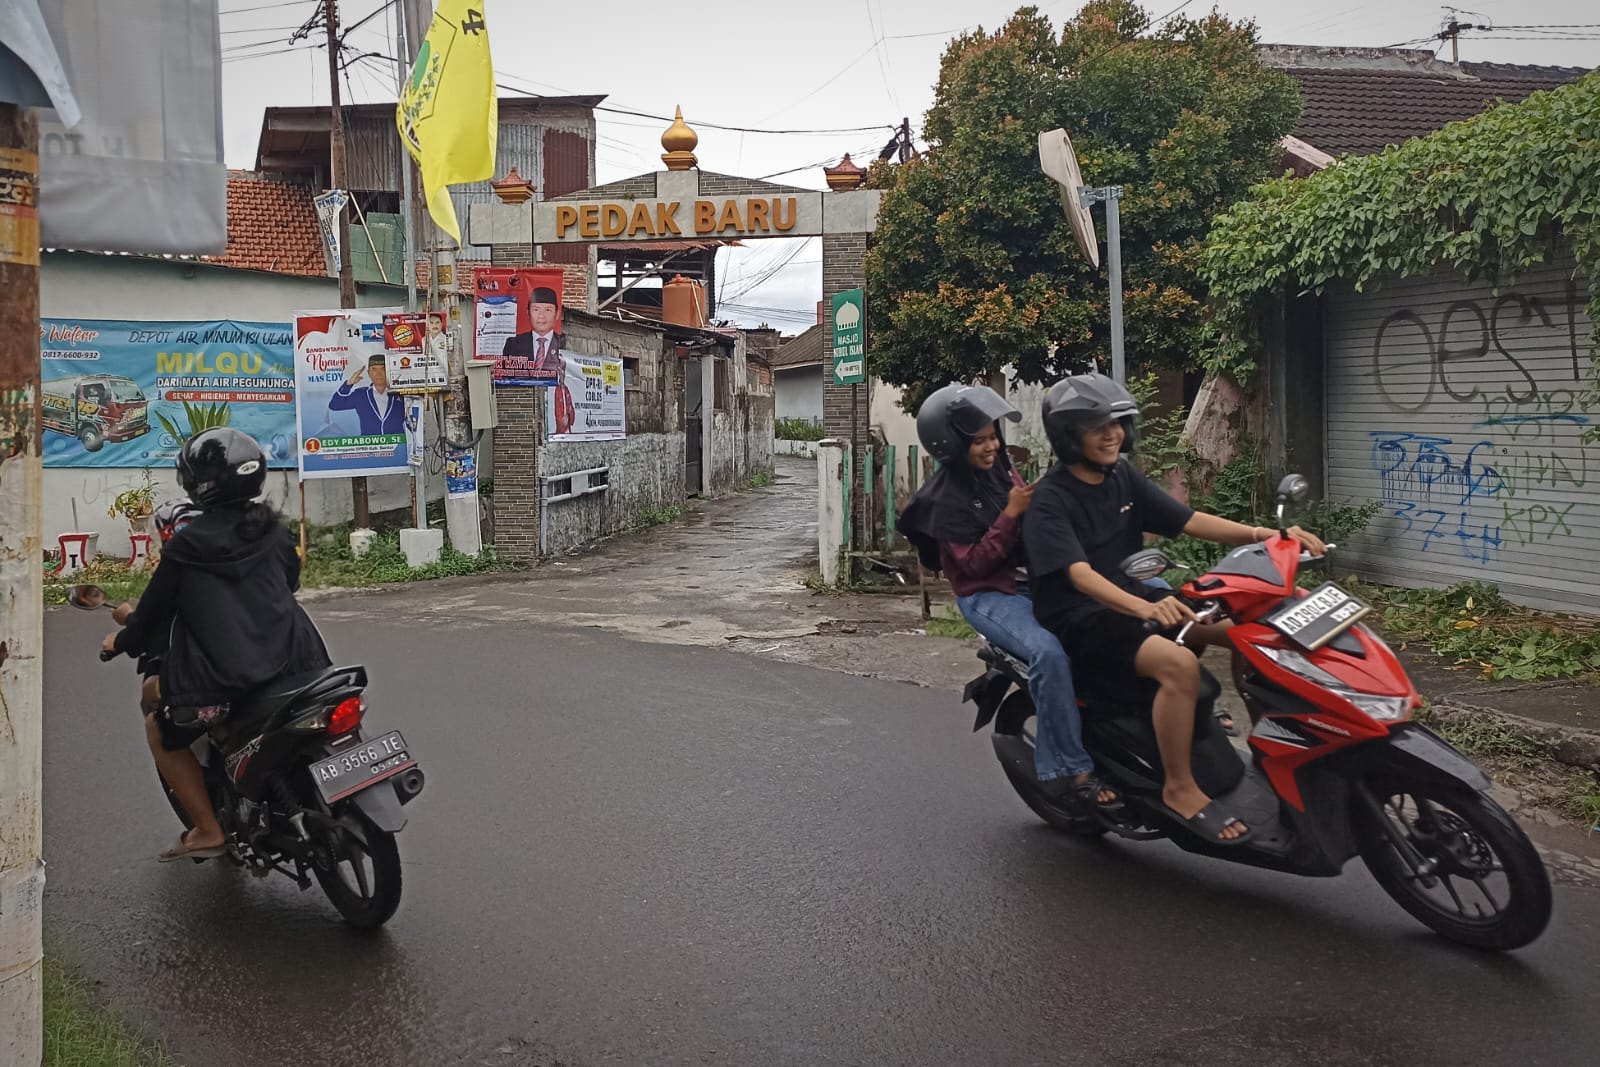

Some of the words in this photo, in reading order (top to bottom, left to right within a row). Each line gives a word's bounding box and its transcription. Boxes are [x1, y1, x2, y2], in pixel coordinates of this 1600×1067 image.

[556, 201, 682, 238] PEDAK
[694, 197, 797, 234] BARU
[128, 331, 173, 343] DEPOT
[176, 330, 199, 345] AIR
[202, 330, 242, 344] MINUM
[347, 328, 360, 338] 14
[156, 351, 263, 375] MILQU
[157, 377, 180, 389] DARI
[182, 377, 210, 389] MATA
[212, 378, 231, 389] AIR
[325, 372, 344, 382] EDY
[200, 392, 230, 401] HIGIENIS
[236, 392, 286, 401] MENYEGARKAN
[308, 440, 317, 452] 1
[322, 439, 341, 448] EDY
[1502, 501, 1576, 547] KPX
[1281, 616, 1303, 633] AD
[1295, 600, 1326, 623] 3904
[1308, 718, 1351, 736] HONDA
[320, 764, 338, 780] AB
[341, 746, 378, 772] 3566
[382, 736, 401, 754] IE
